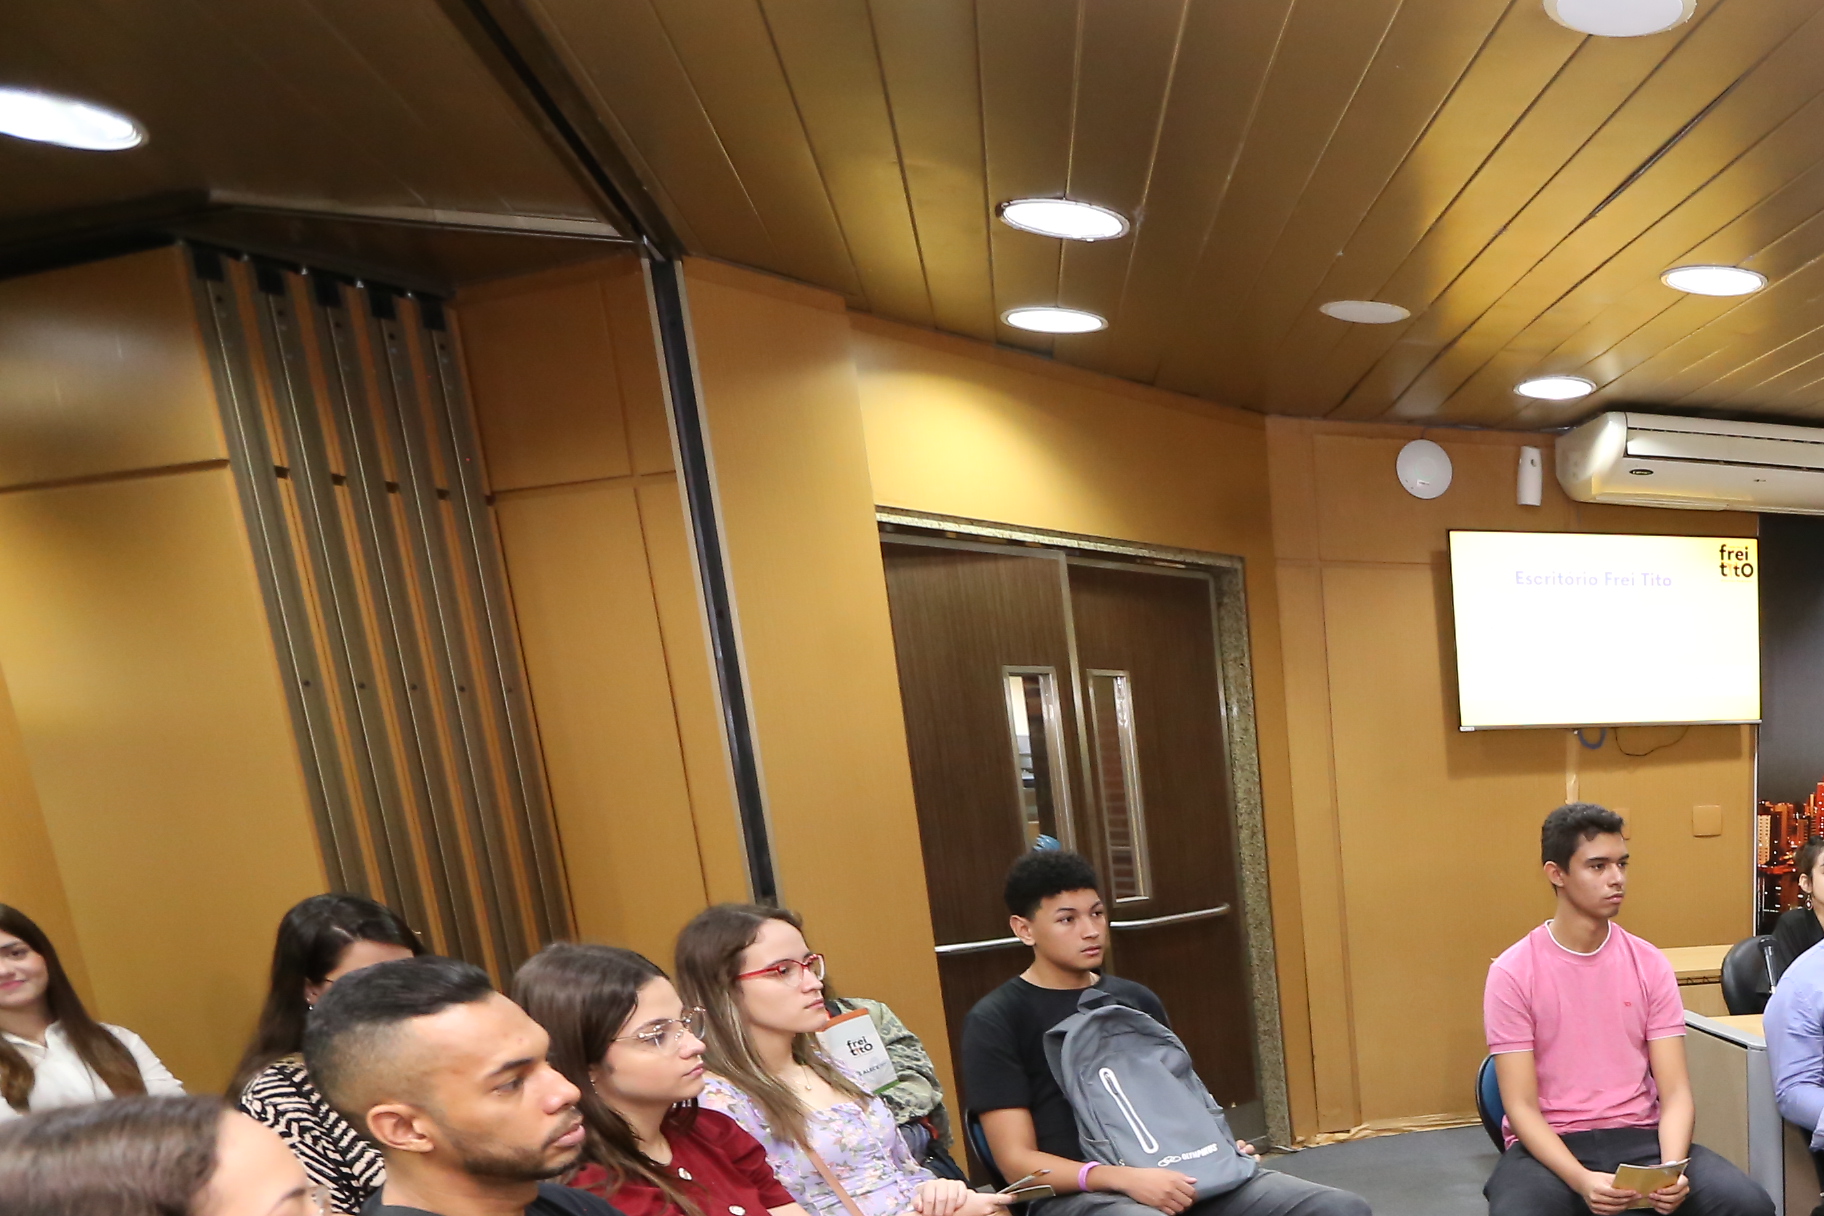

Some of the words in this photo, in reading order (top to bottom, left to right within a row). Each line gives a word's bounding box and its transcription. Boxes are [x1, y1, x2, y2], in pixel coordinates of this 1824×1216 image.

[1719, 544, 1748, 561] frei
[1515, 570, 1598, 586] Escritório
[1604, 571, 1635, 587] Frei
[1641, 572, 1672, 587] Tito
[846, 1036, 868, 1050] frei
